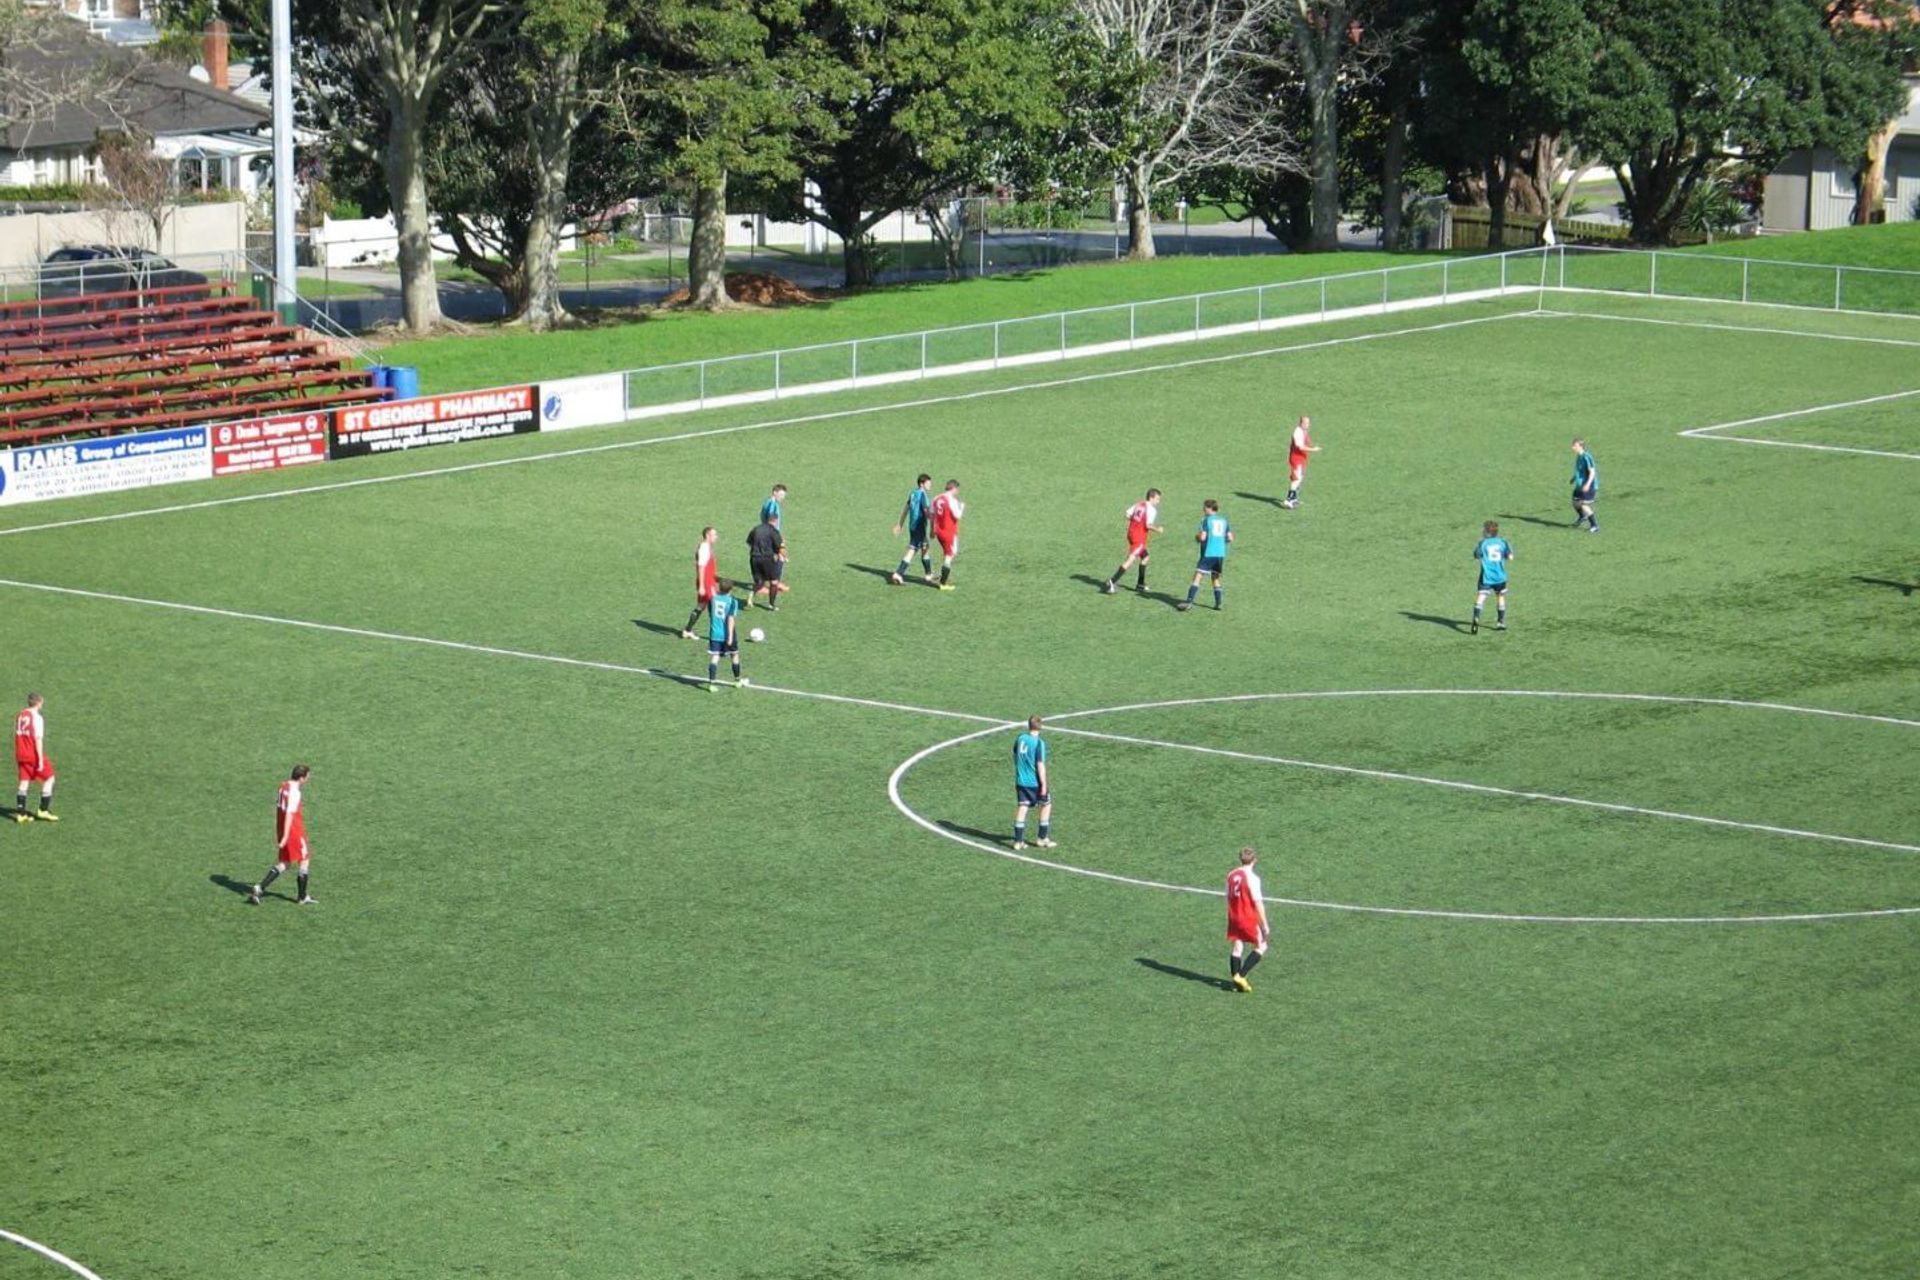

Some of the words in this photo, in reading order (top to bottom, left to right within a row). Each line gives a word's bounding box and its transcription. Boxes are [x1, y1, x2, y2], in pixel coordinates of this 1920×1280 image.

[344, 411, 366, 431] ST
[369, 402, 435, 428] GEORGE
[440, 390, 527, 419] PHARMACY
[18, 446, 78, 472] RAMS
[81, 446, 113, 461] Group
[115, 442, 127, 456] of
[128, 437, 184, 454] Companies
[186, 433, 204, 447] Ltd
[16, 715, 32, 737] 12
